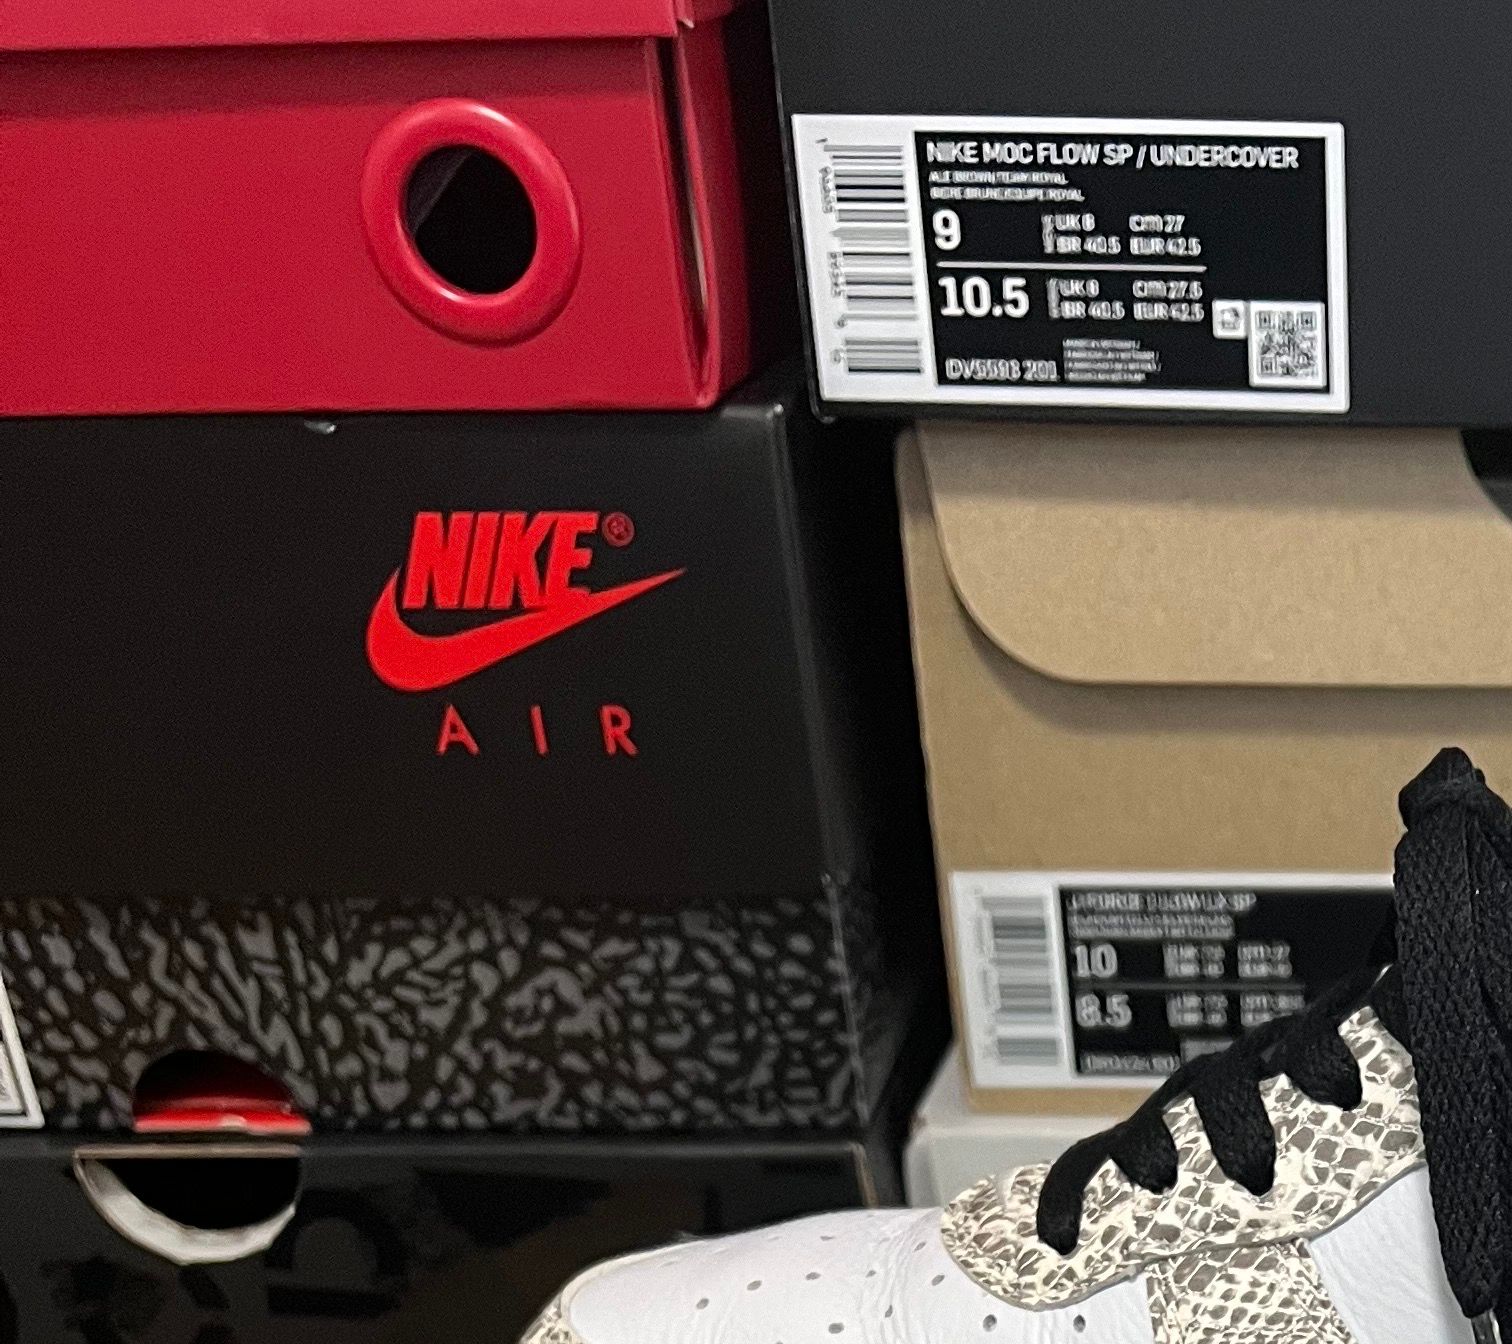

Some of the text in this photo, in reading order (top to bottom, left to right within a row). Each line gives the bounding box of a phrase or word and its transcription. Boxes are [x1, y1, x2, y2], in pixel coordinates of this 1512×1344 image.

[926, 140, 1299, 169] NIKE MOC FLOW SP / UNDERCOVER
[932, 208, 962, 251] 9
[937, 275, 1030, 318] 10.5
[402, 510, 601, 610] NIKE
[436, 704, 639, 757] AIR
[1073, 943, 1119, 979] 10
